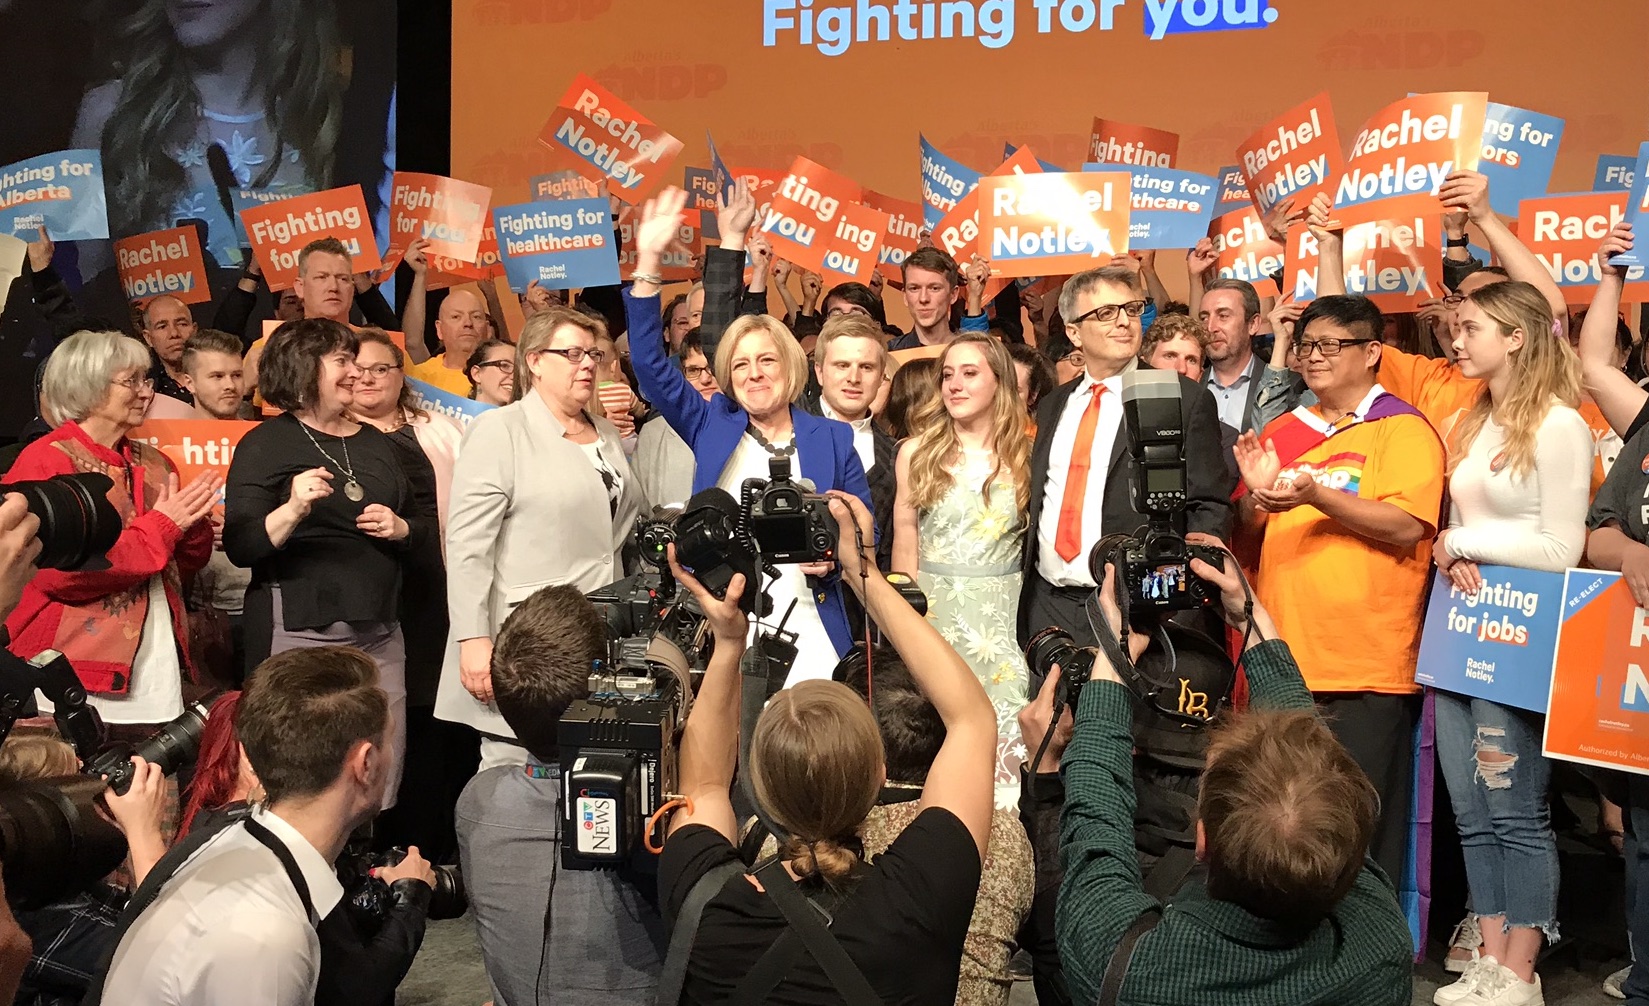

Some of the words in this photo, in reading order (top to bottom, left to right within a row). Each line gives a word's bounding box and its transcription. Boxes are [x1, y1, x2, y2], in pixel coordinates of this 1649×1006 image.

[763, 0, 1014, 56] Fighting
[1033, 0, 1114, 33] for
[574, 88, 668, 163] Rachel
[1349, 104, 1463, 162] Rachel
[1520, 122, 1554, 147] for
[556, 117, 645, 189] Notley
[1244, 108, 1322, 180] Rachel
[0, 166, 55, 192] hting
[59, 160, 93, 177] for
[1179, 178, 1211, 195] for
[1254, 153, 1326, 214] Notley
[1335, 157, 1453, 204] Notley
[252, 206, 361, 244] Fighting
[397, 212, 418, 233] for
[422, 219, 465, 243] you
[499, 211, 573, 235] Fighting
[577, 208, 604, 225] for
[760, 208, 816, 247] you
[119, 234, 190, 270] Rachel
[506, 233, 603, 254] healthcare
[123, 269, 192, 299] Notley
[539, 264, 565, 273] Rachel
[540, 271, 567, 280] Notley.
[1295, 259, 1425, 297] Ntley
[1568, 577, 1603, 607] RE-ELECT
[1447, 606, 1477, 634] for
[1477, 611, 1527, 643] jobs
[1465, 667, 1494, 684] Notley.
[1466, 658, 1495, 672] Rachel
[1578, 744, 1618, 757] Authorized
[1619, 750, 1629, 760] by
[592, 799, 611, 851] NEWS
